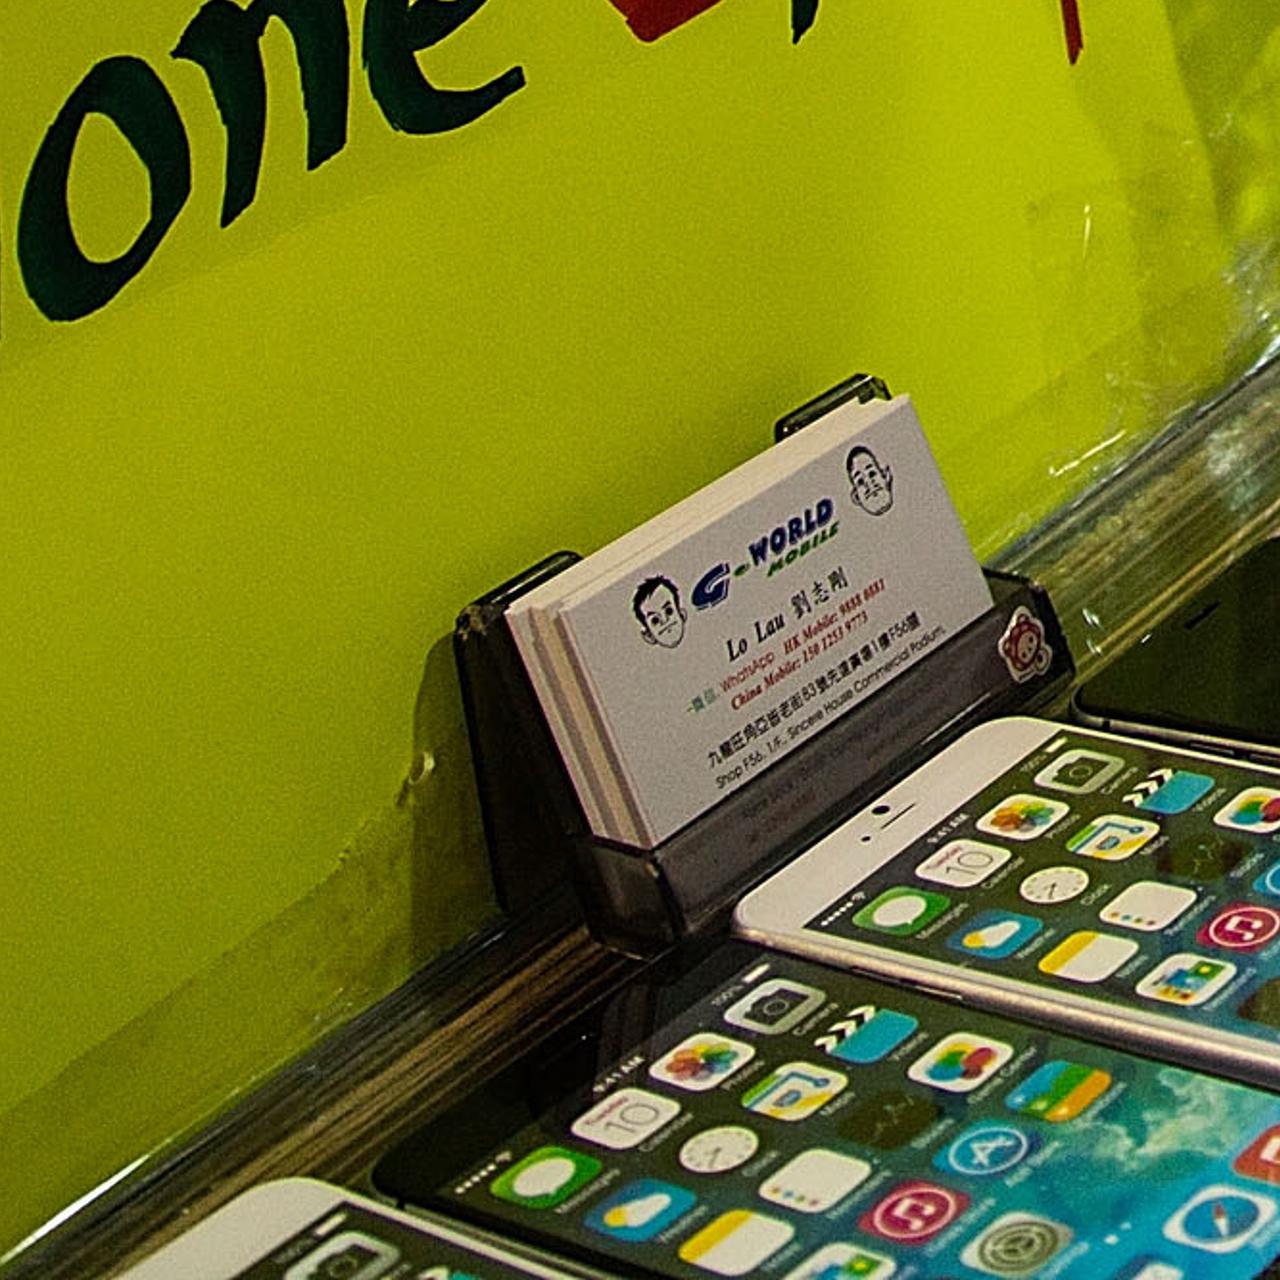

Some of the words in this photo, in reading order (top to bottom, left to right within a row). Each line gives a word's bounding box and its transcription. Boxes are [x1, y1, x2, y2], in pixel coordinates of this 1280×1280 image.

[726, 628, 750, 662] Lo
[754, 611, 786, 645] Lau
[729, 679, 763, 711] China
[937, 848, 1002, 880] 10
[597, 1100, 668, 1138] 10
